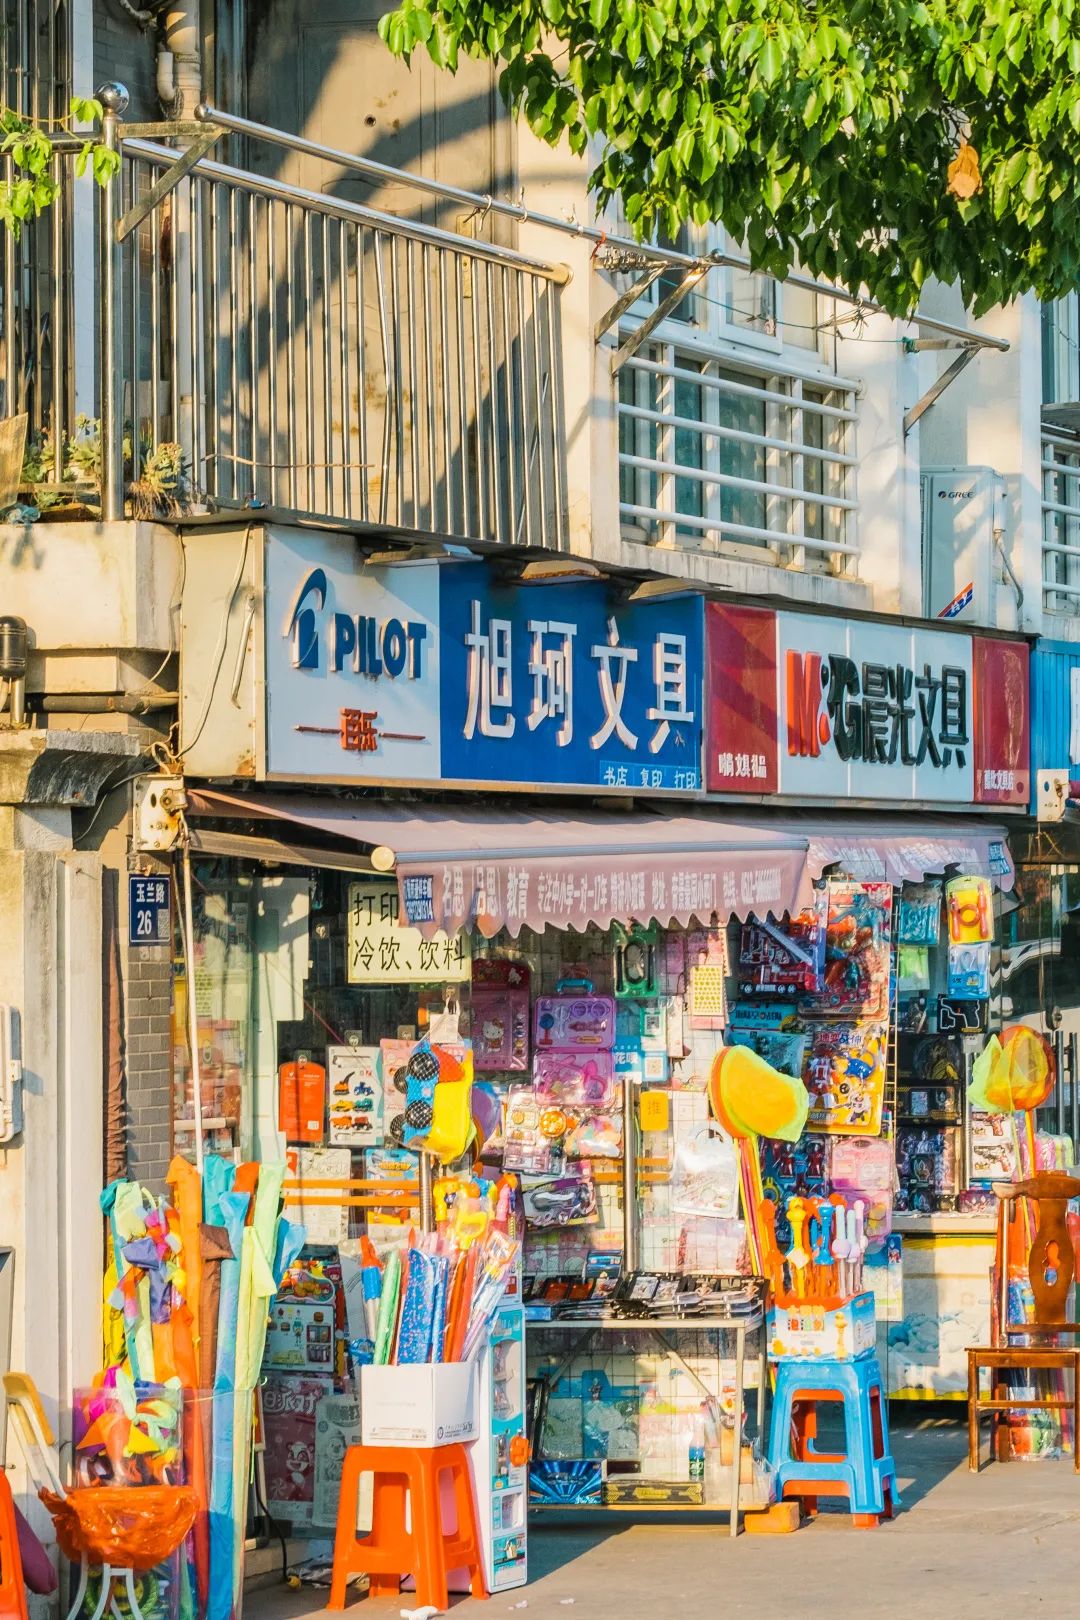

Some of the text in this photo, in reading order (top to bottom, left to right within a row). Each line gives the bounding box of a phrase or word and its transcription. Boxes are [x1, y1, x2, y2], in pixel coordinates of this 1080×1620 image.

[948, 491, 974, 499] GREE
[331, 612, 428, 679] PILOT
[463, 600, 695, 754] 旭珂文具
[603, 765, 696, 790] 书店 复印 打印
[136, 883, 165, 904] 玉兰路
[137, 910, 152, 935] 26
[353, 892, 400, 927] 打印
[353, 935, 466, 971] 冷饮、饮料
